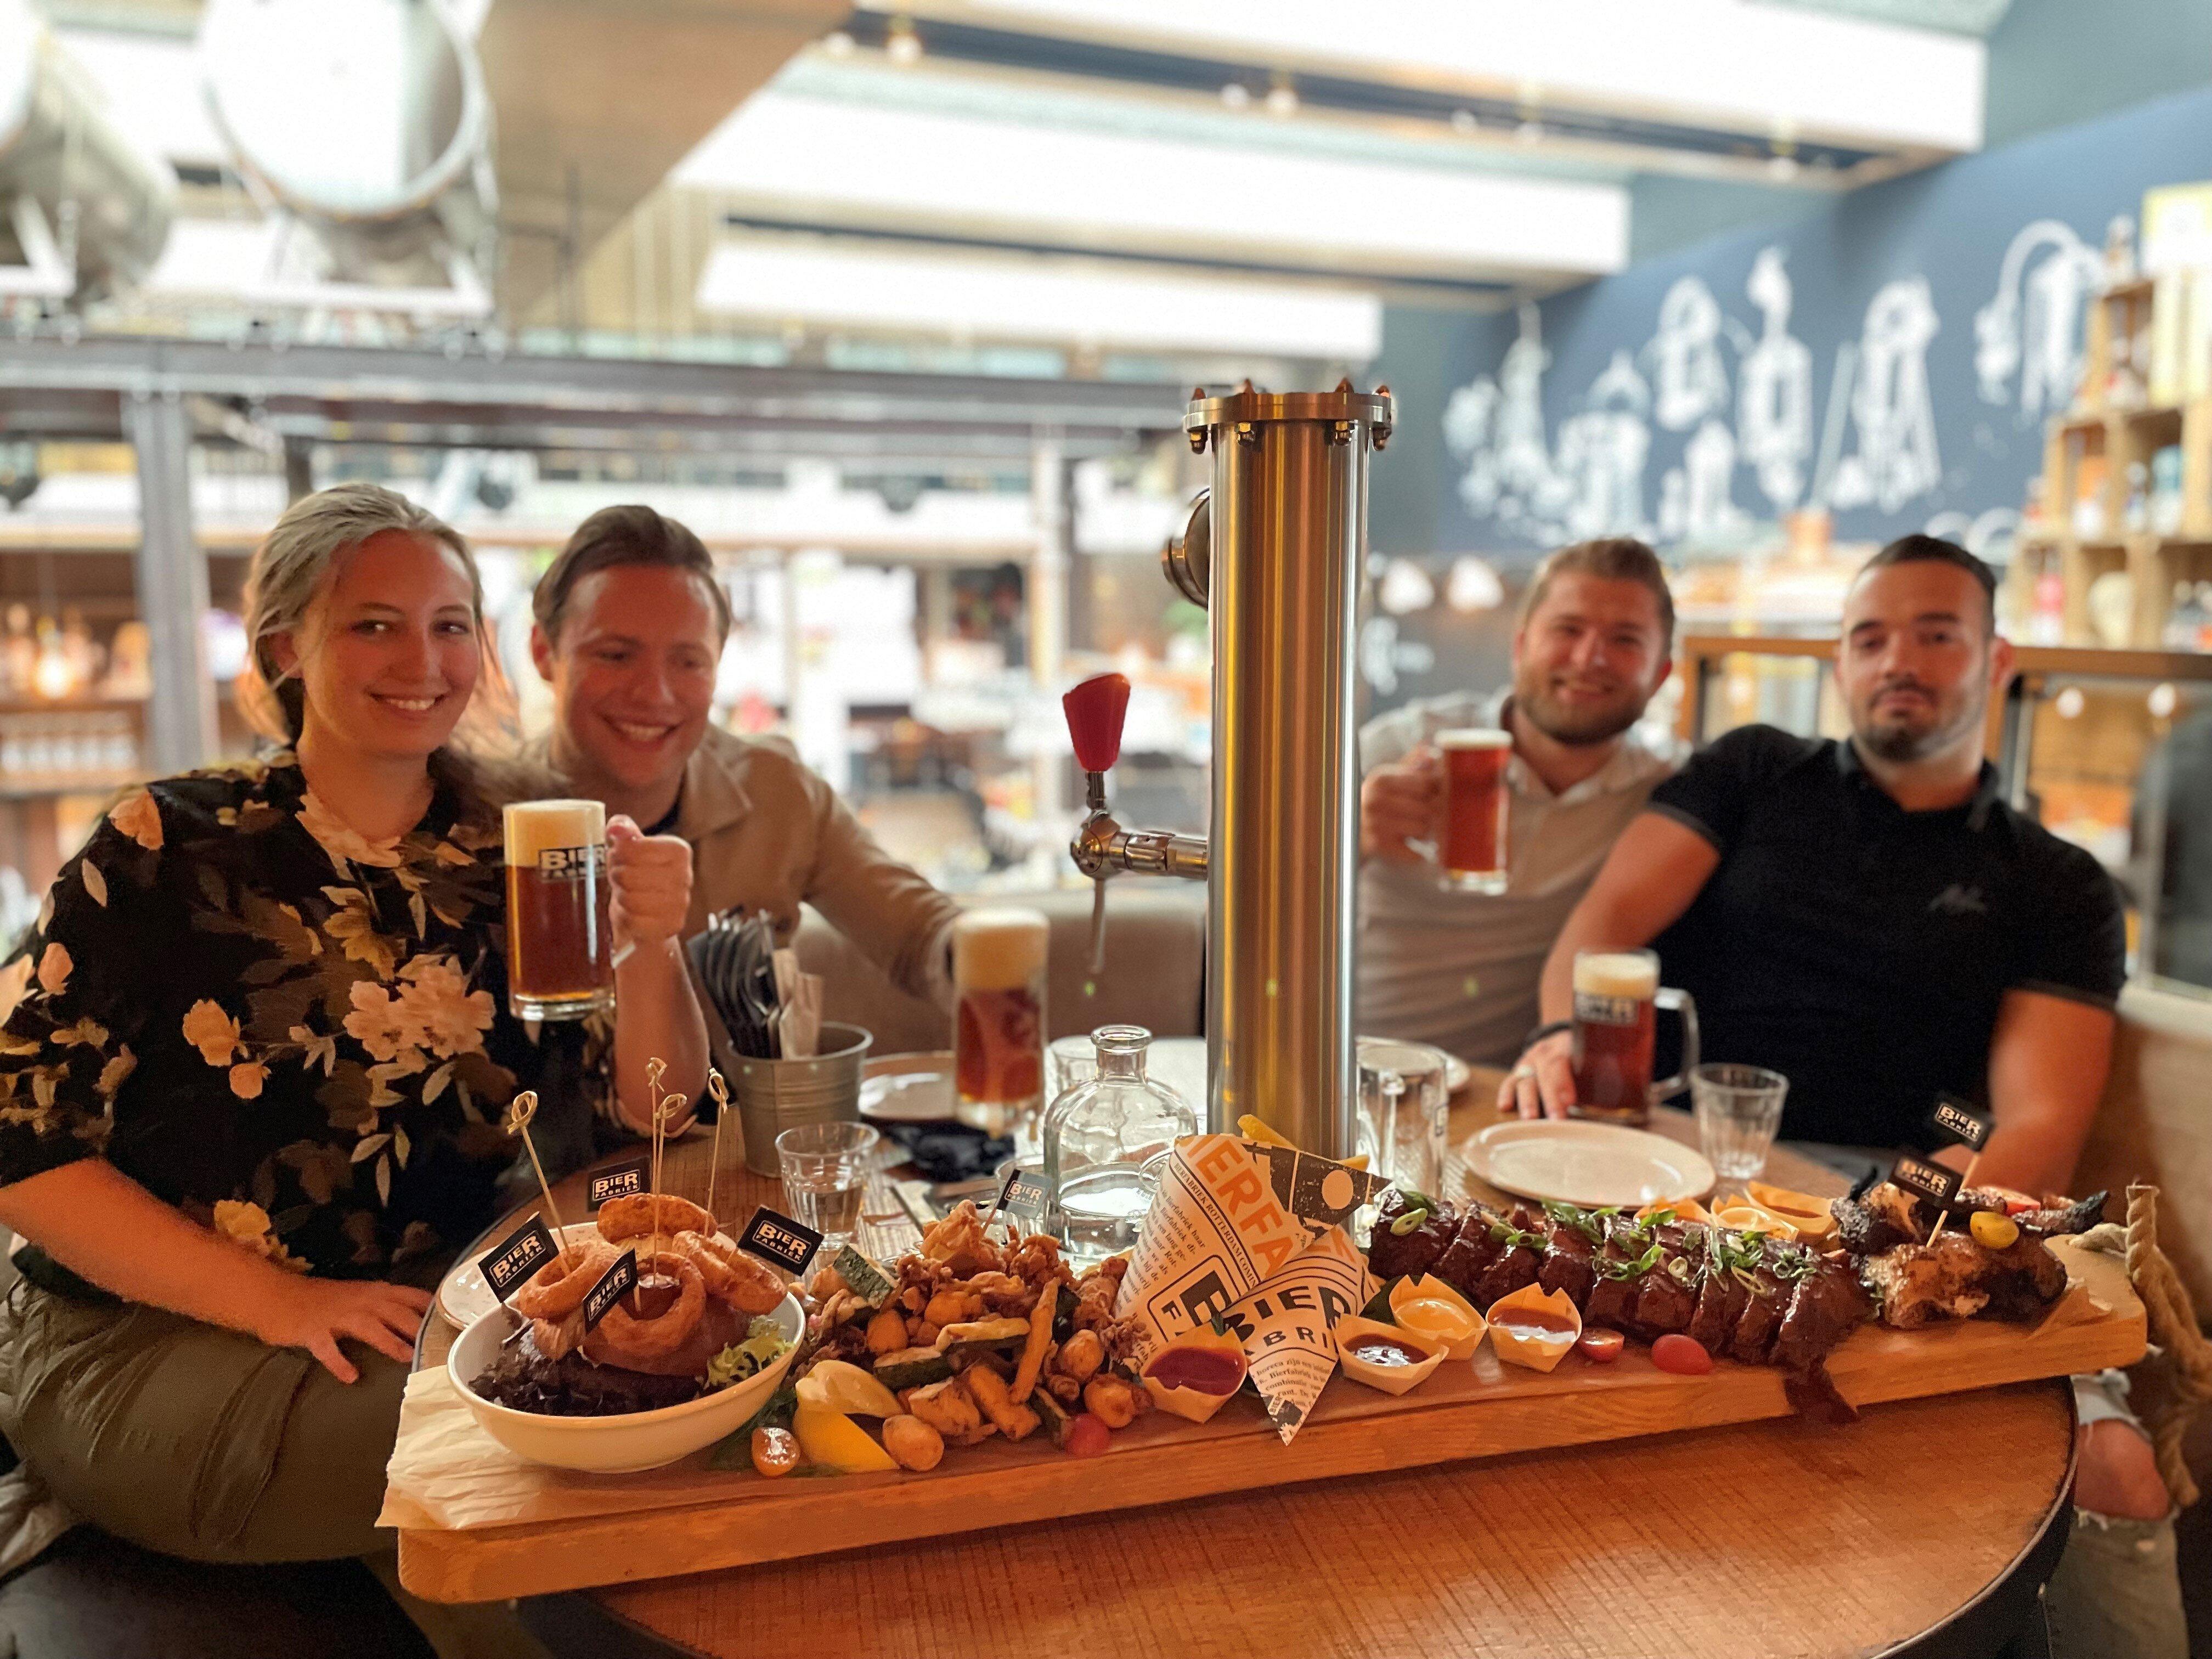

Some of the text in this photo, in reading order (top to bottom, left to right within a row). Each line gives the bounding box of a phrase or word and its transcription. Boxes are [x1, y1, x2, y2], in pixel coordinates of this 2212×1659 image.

[541, 847, 605, 870] BIER
[1940, 1106, 1980, 1135] BIER
[595, 1173, 638, 1194] BIER
[1901, 1158, 1947, 1189] BIER
[1010, 1183, 1042, 1200] BIER
[1173, 1162, 1209, 1204] BIERFABRIEK
[1206, 1204, 1242, 1258] ROTTERDAM
[759, 1223, 807, 1256] BIER
[493, 1235, 540, 1279] BIER
[590, 1268, 627, 1312] BIER
